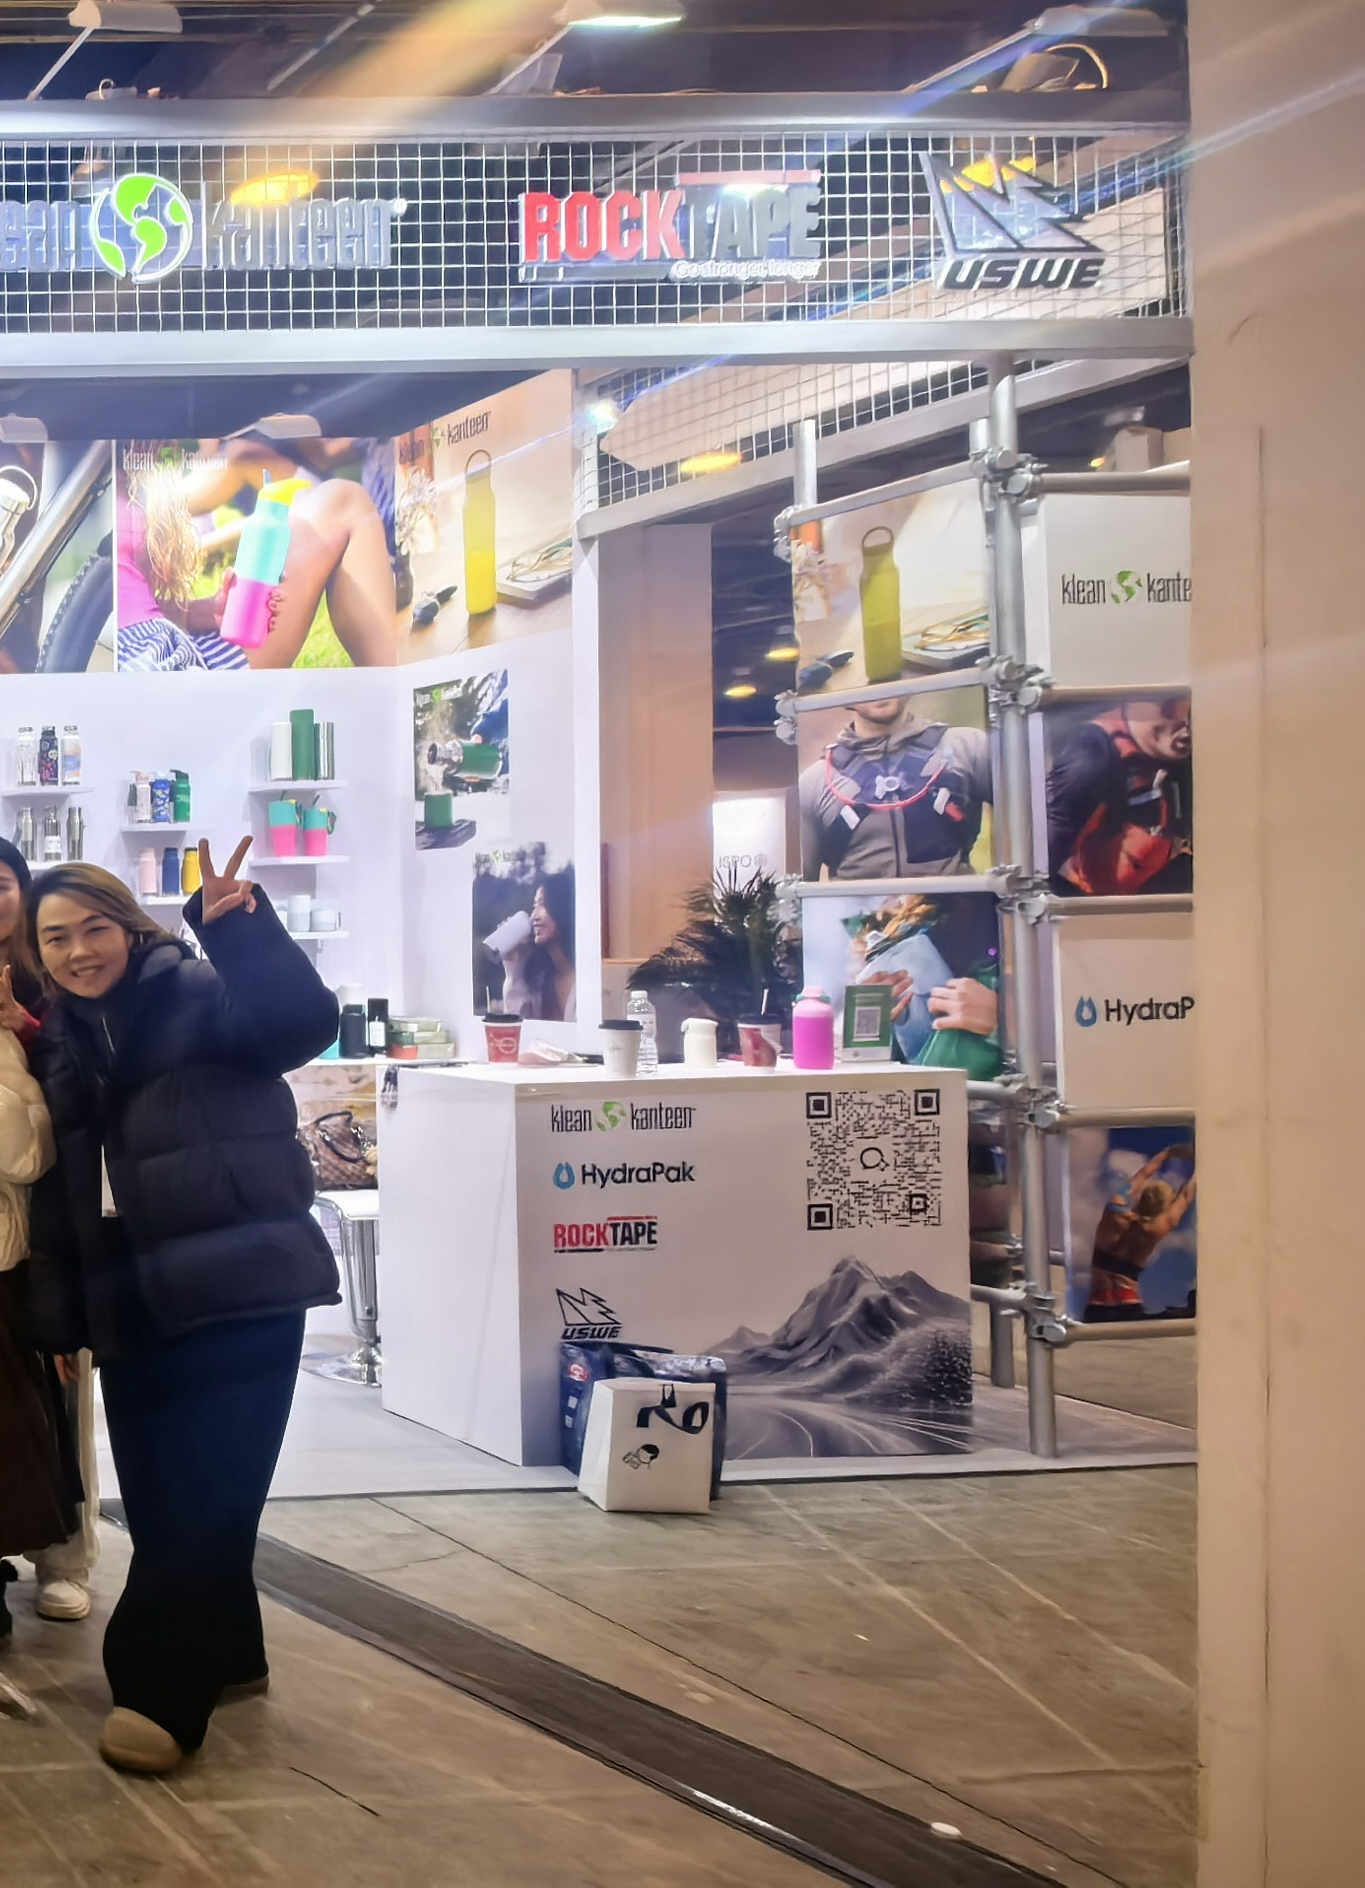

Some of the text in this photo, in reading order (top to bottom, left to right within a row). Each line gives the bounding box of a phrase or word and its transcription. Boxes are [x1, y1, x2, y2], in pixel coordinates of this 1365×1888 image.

[519, 185, 821, 262] ROCKTAPE
[942, 257, 1106, 290] USWE
[1061, 571, 1192, 605] klean kante
[1104, 996, 1195, 1026] HydraP
[551, 1101, 693, 1133] klean kanteen
[581, 1160, 696, 1189] HydraPak
[553, 1221, 658, 1248] ROCKTAPE
[560, 1326, 623, 1340] USWE
